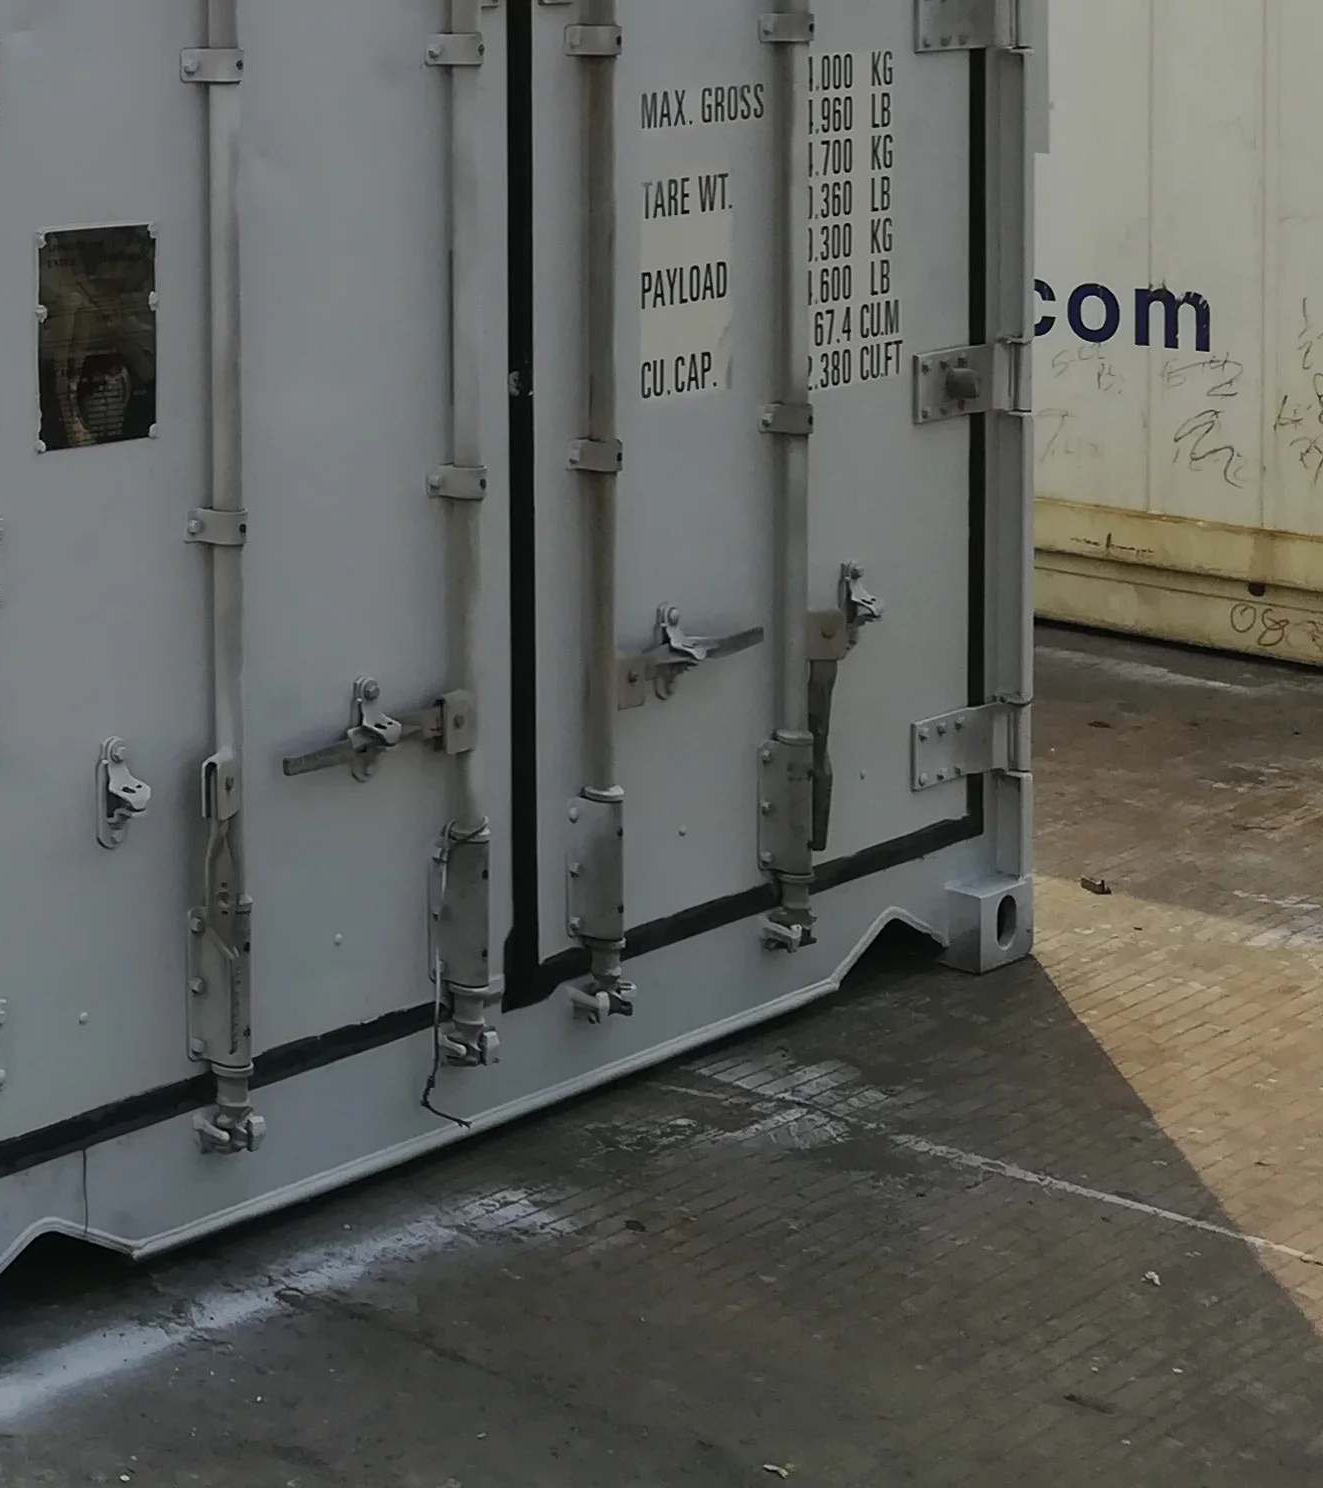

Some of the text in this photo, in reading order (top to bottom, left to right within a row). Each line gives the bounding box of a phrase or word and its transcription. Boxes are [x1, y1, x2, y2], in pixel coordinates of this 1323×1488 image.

[871, 50, 893, 86] KG
[641, 83, 764, 129] MAX. GROSS
[871, 92, 891, 128] LB
[871, 134, 893, 170] KG
[641, 173, 733, 219] TARE WT.
[871, 176, 891, 212] LB
[870, 217, 893, 254] KG
[641, 261, 728, 310] PAYLOAD
[870, 259, 891, 296] LB
[814, 306, 852, 346] 67.4
